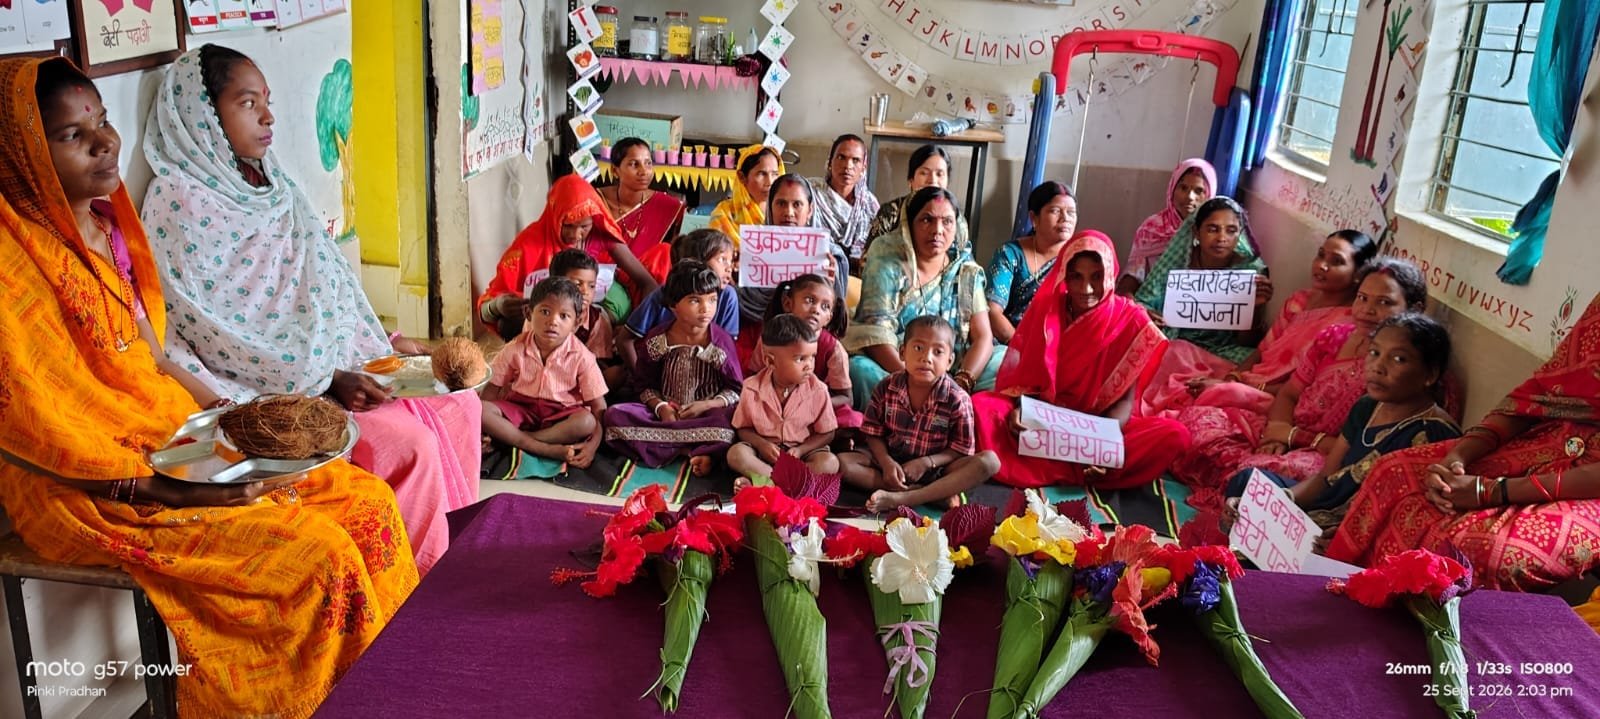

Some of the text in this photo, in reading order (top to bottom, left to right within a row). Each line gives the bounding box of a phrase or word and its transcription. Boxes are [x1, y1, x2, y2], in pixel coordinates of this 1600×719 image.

[571, 7, 586, 27] T
[922, 20, 938, 35] J
[940, 29, 954, 47] K
[964, 38, 975, 56] L
[981, 41, 998, 58] M
[1006, 43, 1020, 60] N
[1029, 40, 1045, 56] O
[1112, 6, 1126, 21] S
[100, 19, 123, 48] बेटी
[743, 230, 826, 256] सुकन्या
[1176, 293, 1248, 325] योजना
[1031, 401, 1099, 432] पोषण
[1022, 424, 1123, 468] अभियान
[1247, 470, 1275, 512] बेटी
[1234, 505, 1269, 558] बेटी
